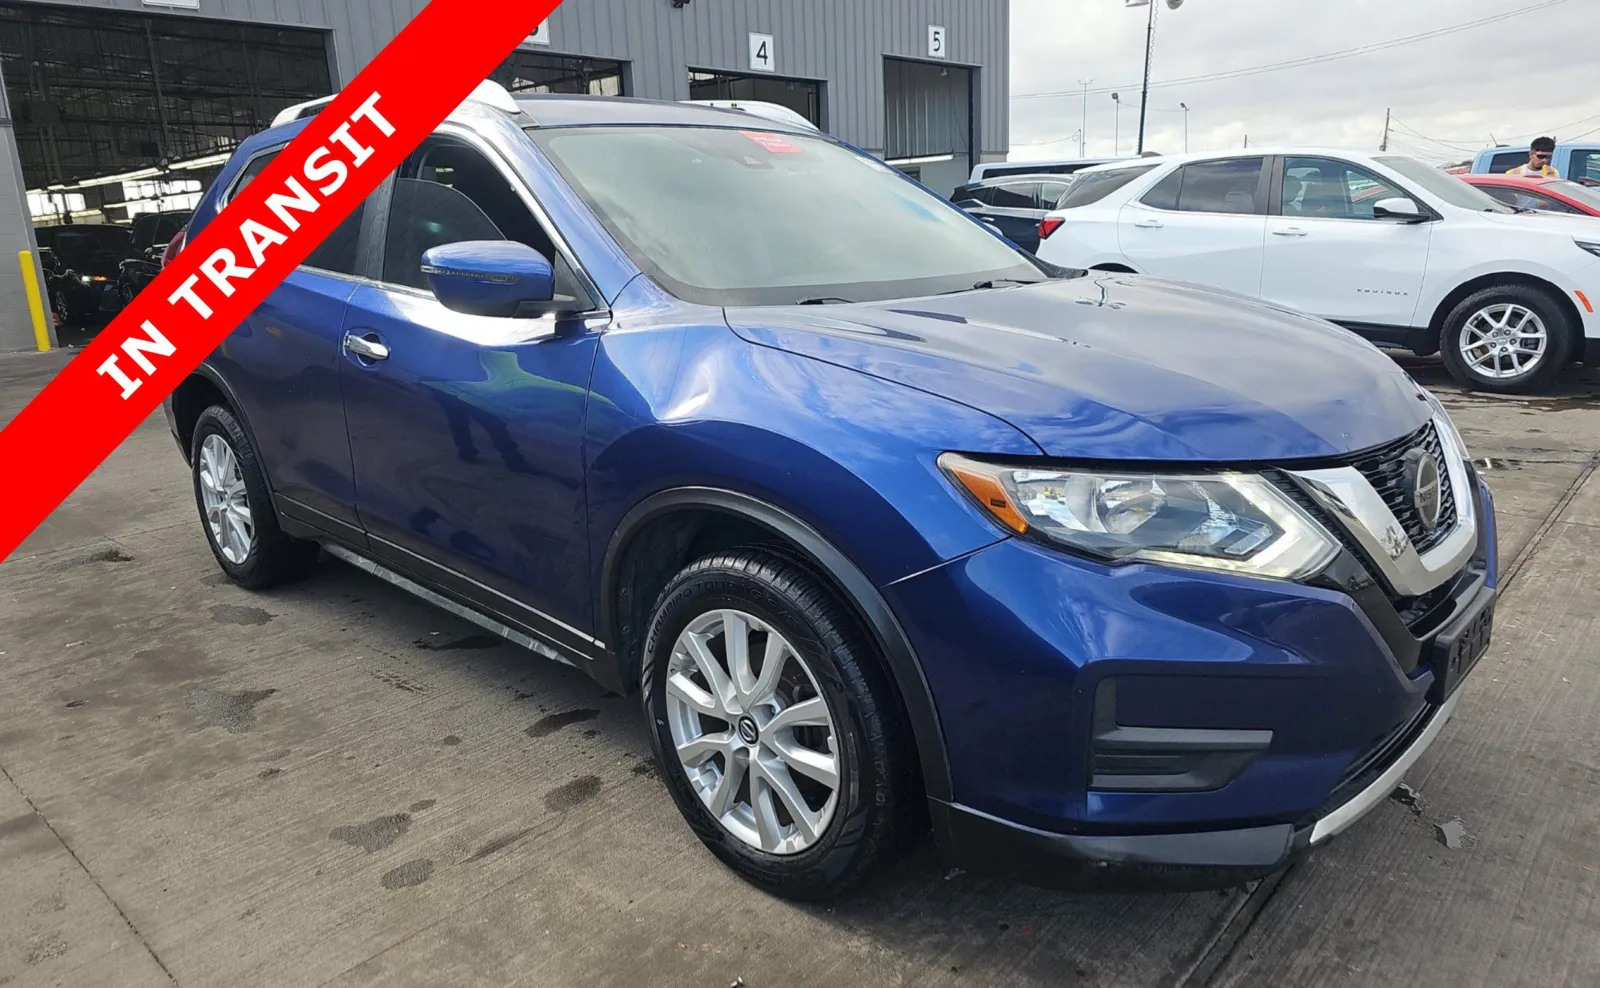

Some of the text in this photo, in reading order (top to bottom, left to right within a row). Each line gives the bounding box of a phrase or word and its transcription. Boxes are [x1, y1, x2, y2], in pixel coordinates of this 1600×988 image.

[933, 31, 942, 52] 5
[756, 41, 768, 65] 4
[1356, 288, 1408, 296] EQUINOX
[647, 587, 693, 653] CHAMPIRO
